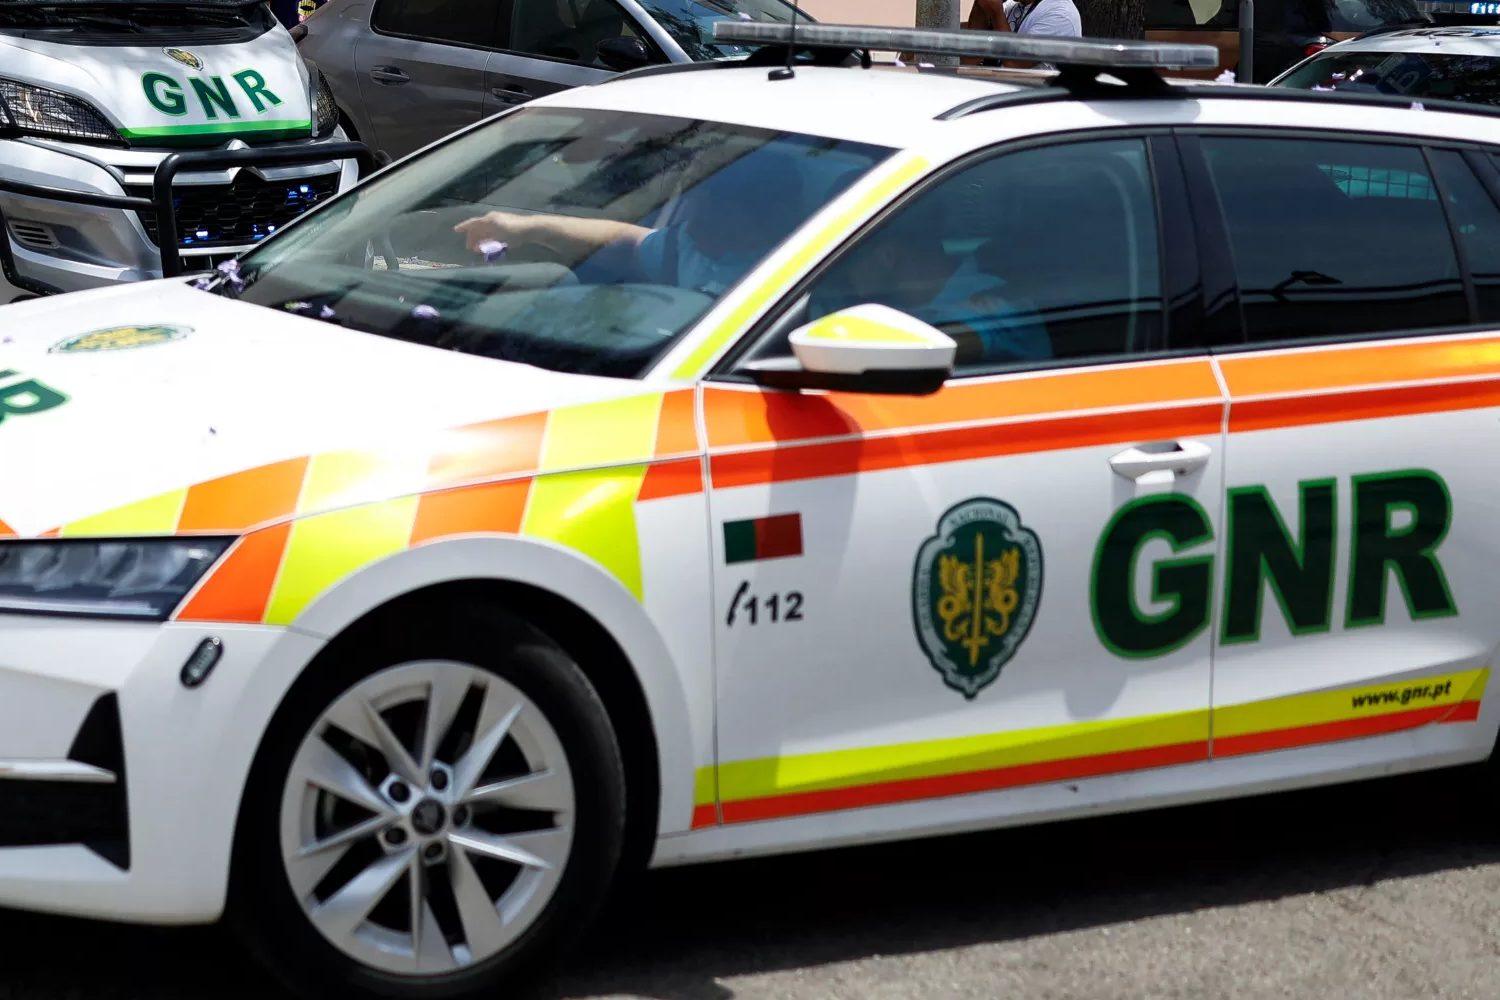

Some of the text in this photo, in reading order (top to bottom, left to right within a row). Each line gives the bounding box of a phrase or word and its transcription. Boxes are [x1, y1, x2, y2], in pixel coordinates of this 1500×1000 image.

[140, 68, 285, 120] GNR
[1088, 468, 1459, 660] GNR
[743, 591, 804, 625] 112
[1351, 679, 1452, 708] www.gnr.pt
